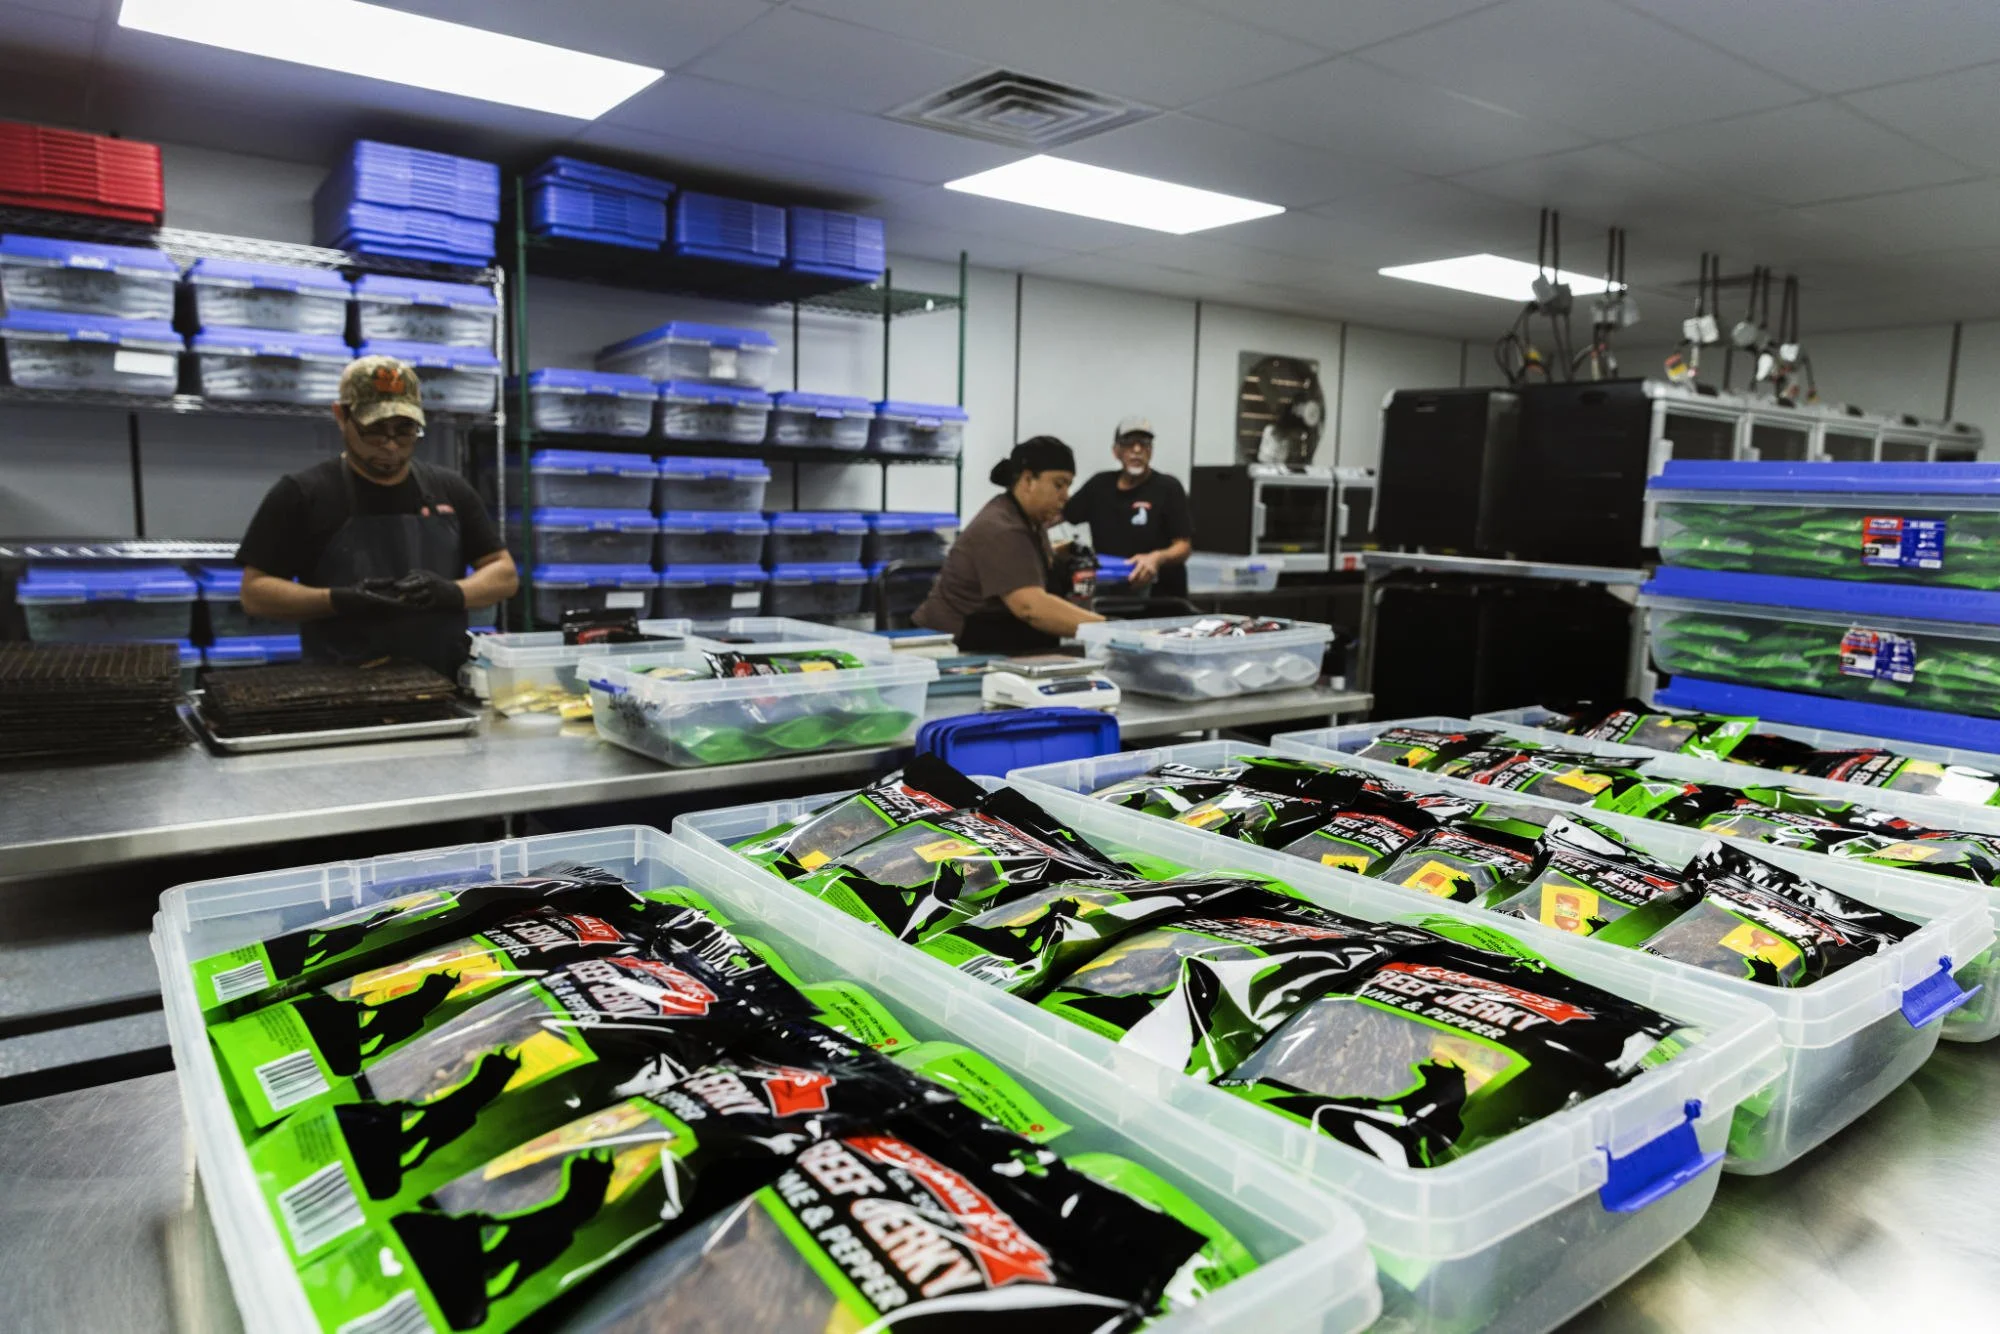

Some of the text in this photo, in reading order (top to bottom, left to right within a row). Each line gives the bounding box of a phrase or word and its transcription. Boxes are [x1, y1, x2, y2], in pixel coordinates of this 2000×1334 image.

[867, 794, 895, 811] LIME
[1576, 873, 1592, 881] &
[1597, 870, 1664, 902] JERKY
[1376, 970, 1548, 1031] BEEF JERKY
[1402, 1000, 1424, 1012] &
[1423, 1006, 1508, 1040] PEPPER
[797, 1138, 888, 1196] BEEF
[850, 1197, 983, 1298] JERKY
[800, 1204, 835, 1230] &
[817, 1223, 909, 1312] PEPPER
